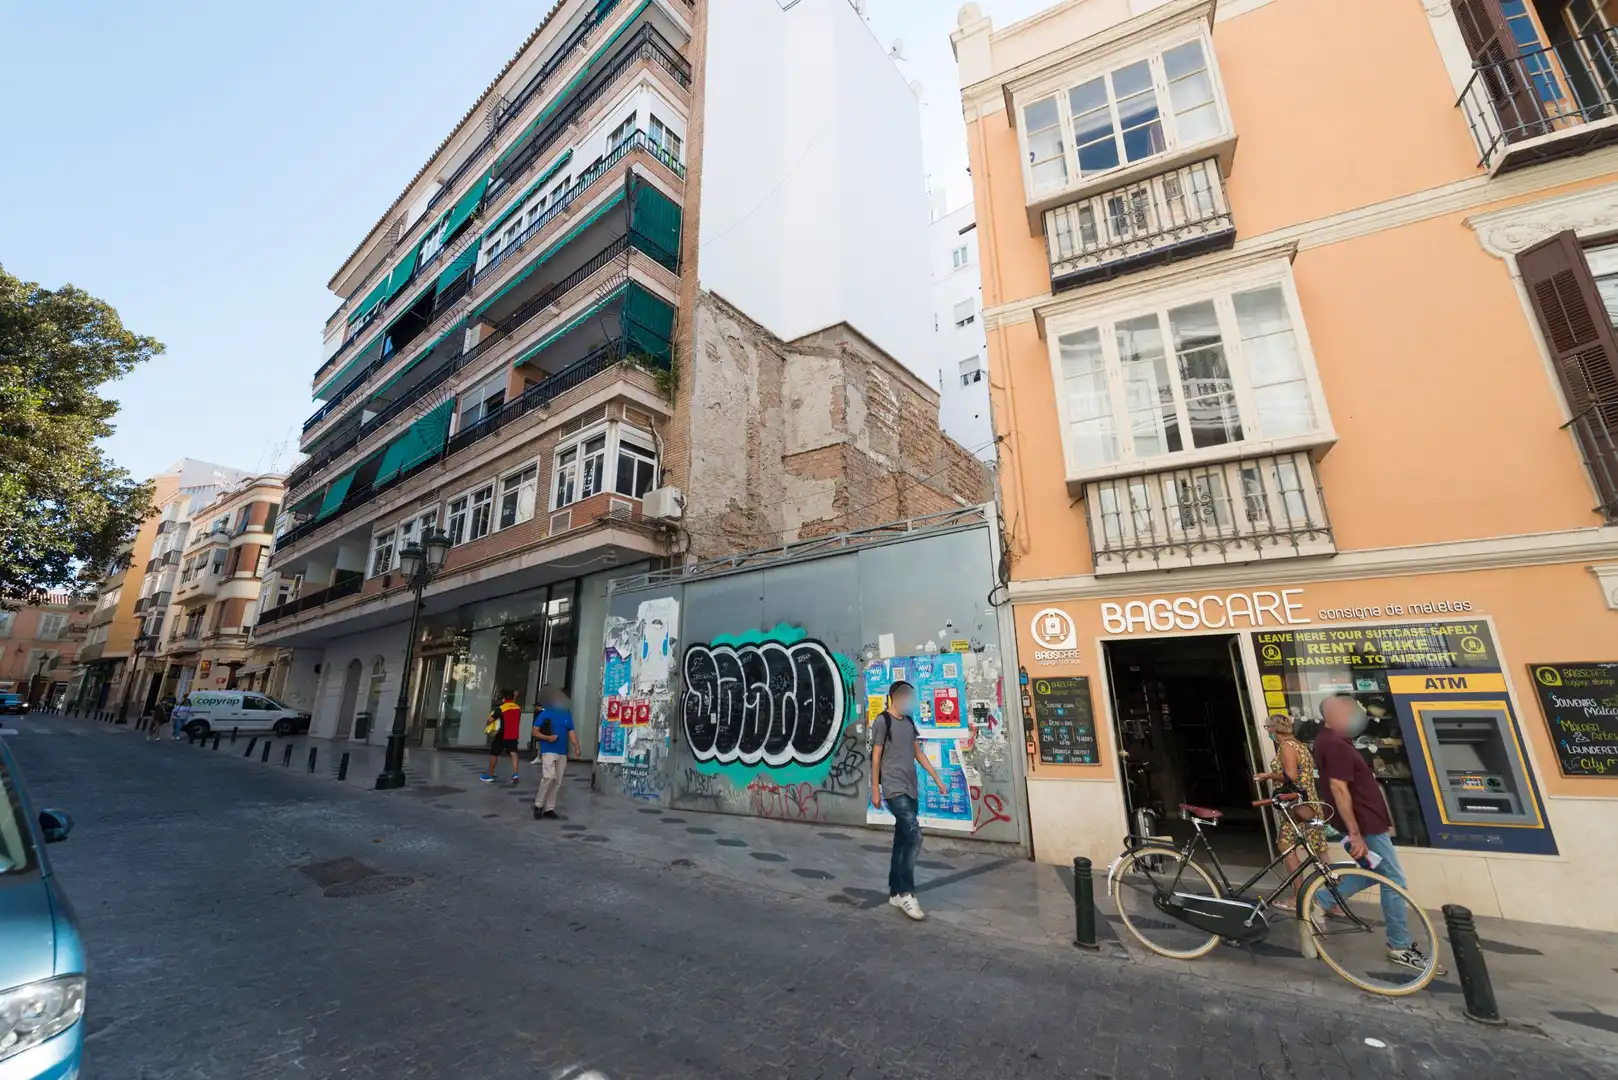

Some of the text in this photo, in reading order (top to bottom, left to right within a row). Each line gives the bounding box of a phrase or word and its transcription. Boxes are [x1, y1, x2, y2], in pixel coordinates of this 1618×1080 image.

[1101, 588, 1311, 634] BAGSCARE
[1318, 598, 1473, 621] consigna de maletas
[1258, 624, 1478, 643] LEAVE HERE YOUR SUITCASE SAFELY
[1307, 638, 1429, 655] RENT A BIKE
[1287, 656, 1362, 667] TRANSFER
[1364, 654, 1386, 664] TO
[1390, 652, 1457, 664] AIRPORT
[1424, 677, 1467, 690] ATM
[196, 697, 240, 708] copyrap
